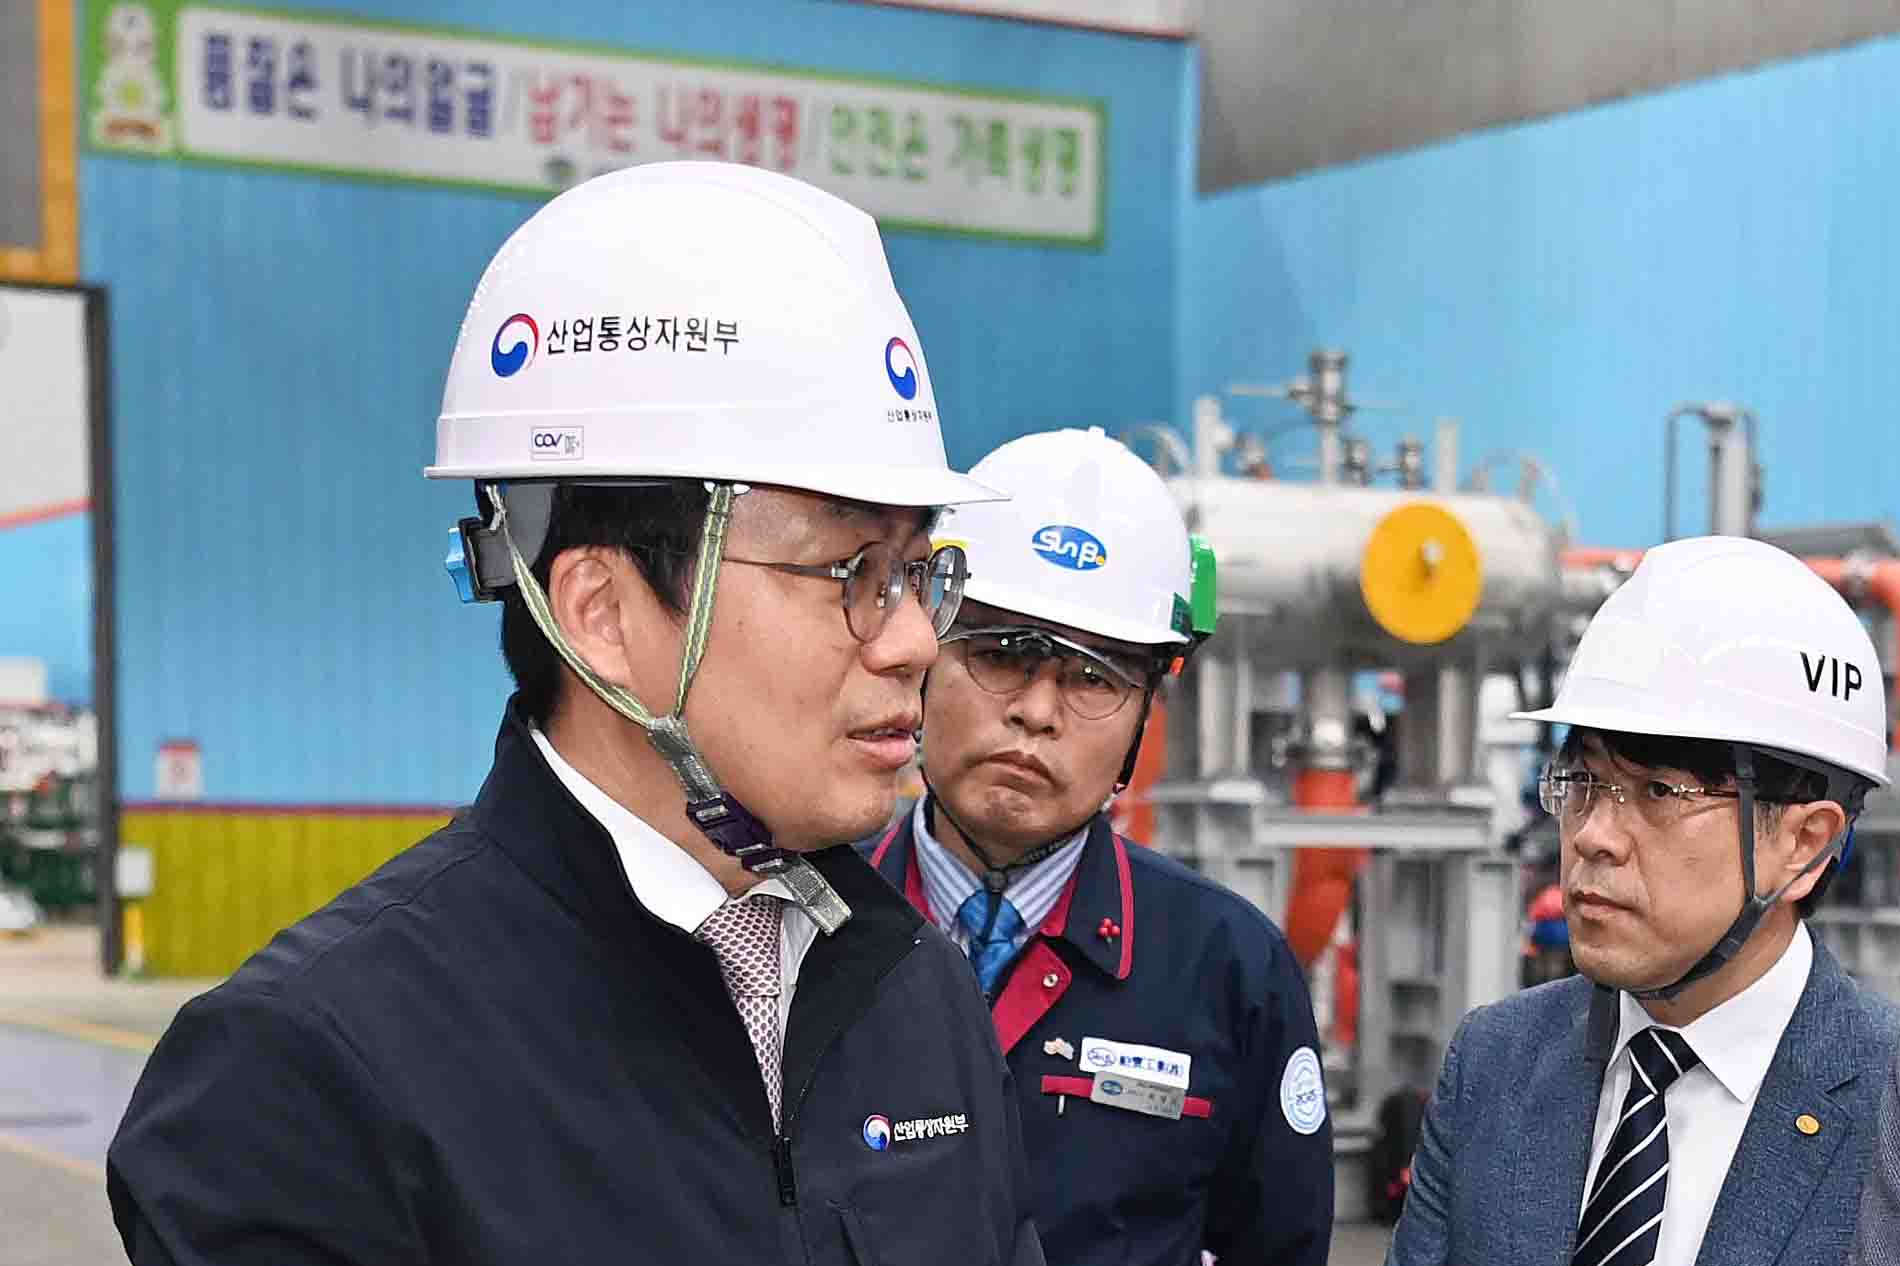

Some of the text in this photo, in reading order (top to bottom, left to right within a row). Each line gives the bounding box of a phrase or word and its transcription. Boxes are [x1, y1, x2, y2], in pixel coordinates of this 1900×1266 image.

[547, 316, 740, 355] 산업통상자원부
[1800, 651, 1862, 701] VIP
[894, 1114, 968, 1141] 산업통상자원부
